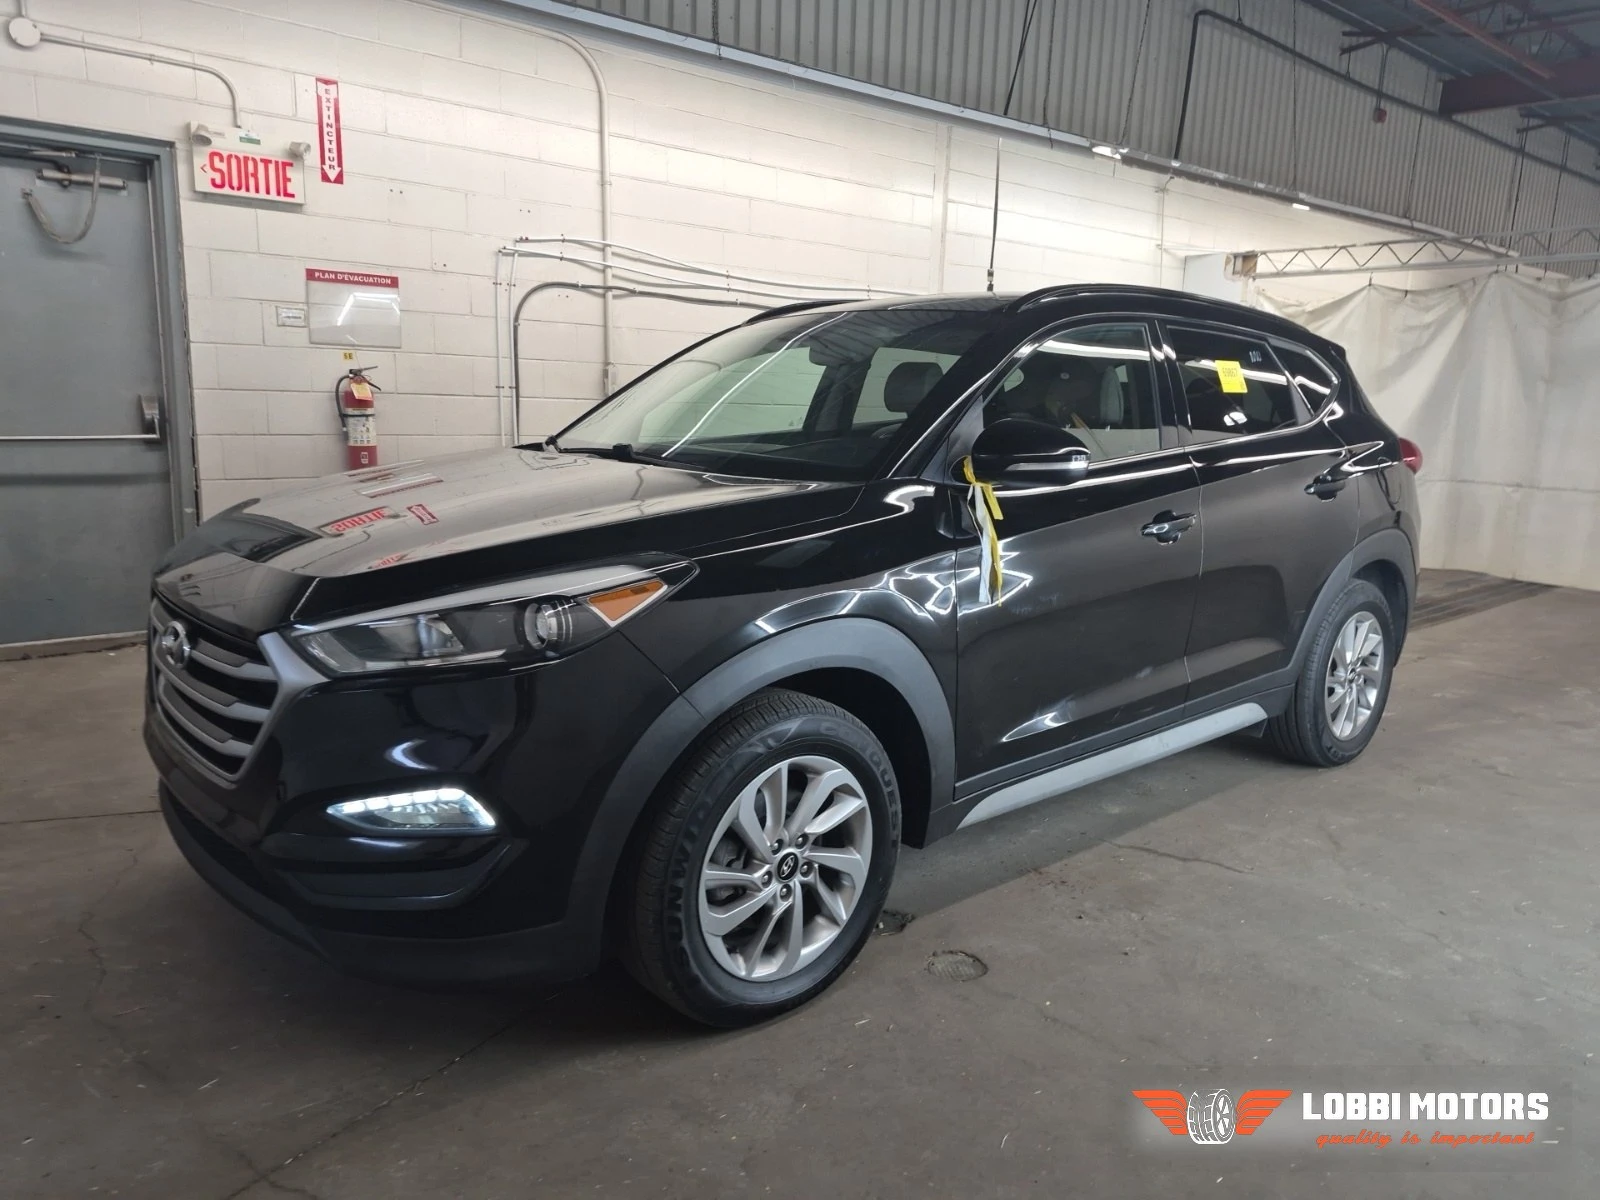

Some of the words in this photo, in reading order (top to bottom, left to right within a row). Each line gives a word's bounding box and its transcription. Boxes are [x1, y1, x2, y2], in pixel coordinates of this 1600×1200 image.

[324, 88, 336, 171] EXTINCTEUR
[208, 150, 296, 199] SORTIE
[314, 271, 335, 280] PLAN
